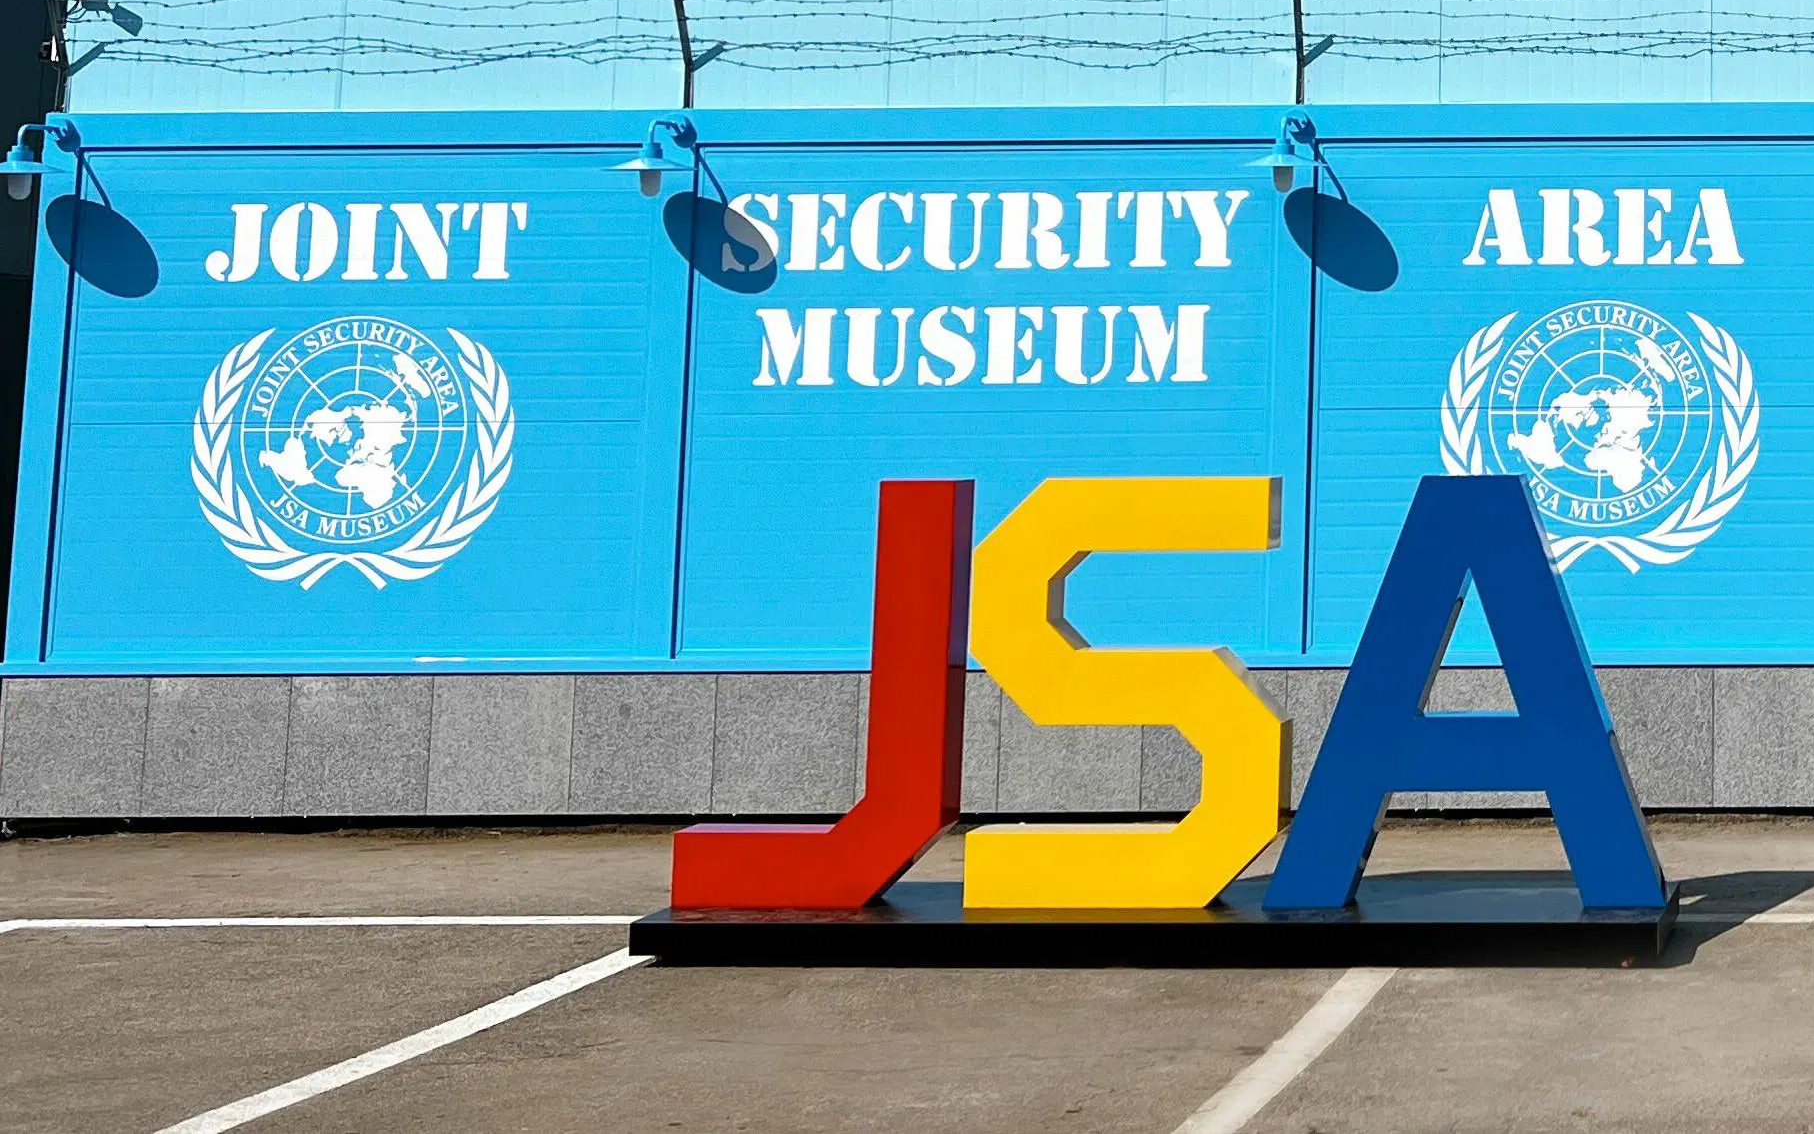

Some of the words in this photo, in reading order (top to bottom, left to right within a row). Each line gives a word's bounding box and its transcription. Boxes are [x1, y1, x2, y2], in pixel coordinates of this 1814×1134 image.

[205, 202, 529, 283] JOINT
[721, 189, 1250, 272] SECURITY
[1462, 188, 1745, 266] AREA
[250, 346, 300, 419] JOINT
[304, 321, 424, 353] SECURITY
[419, 355, 461, 417] AREA
[752, 304, 1211, 387] MUSEUM
[1497, 332, 1544, 400] JOINT
[1546, 305, 1666, 340] SECURITY
[1663, 339, 1704, 400] AREA
[269, 493, 308, 529] JSA
[317, 492, 427, 537] MUSEUM
[1568, 476, 1676, 521] MUSEUM
